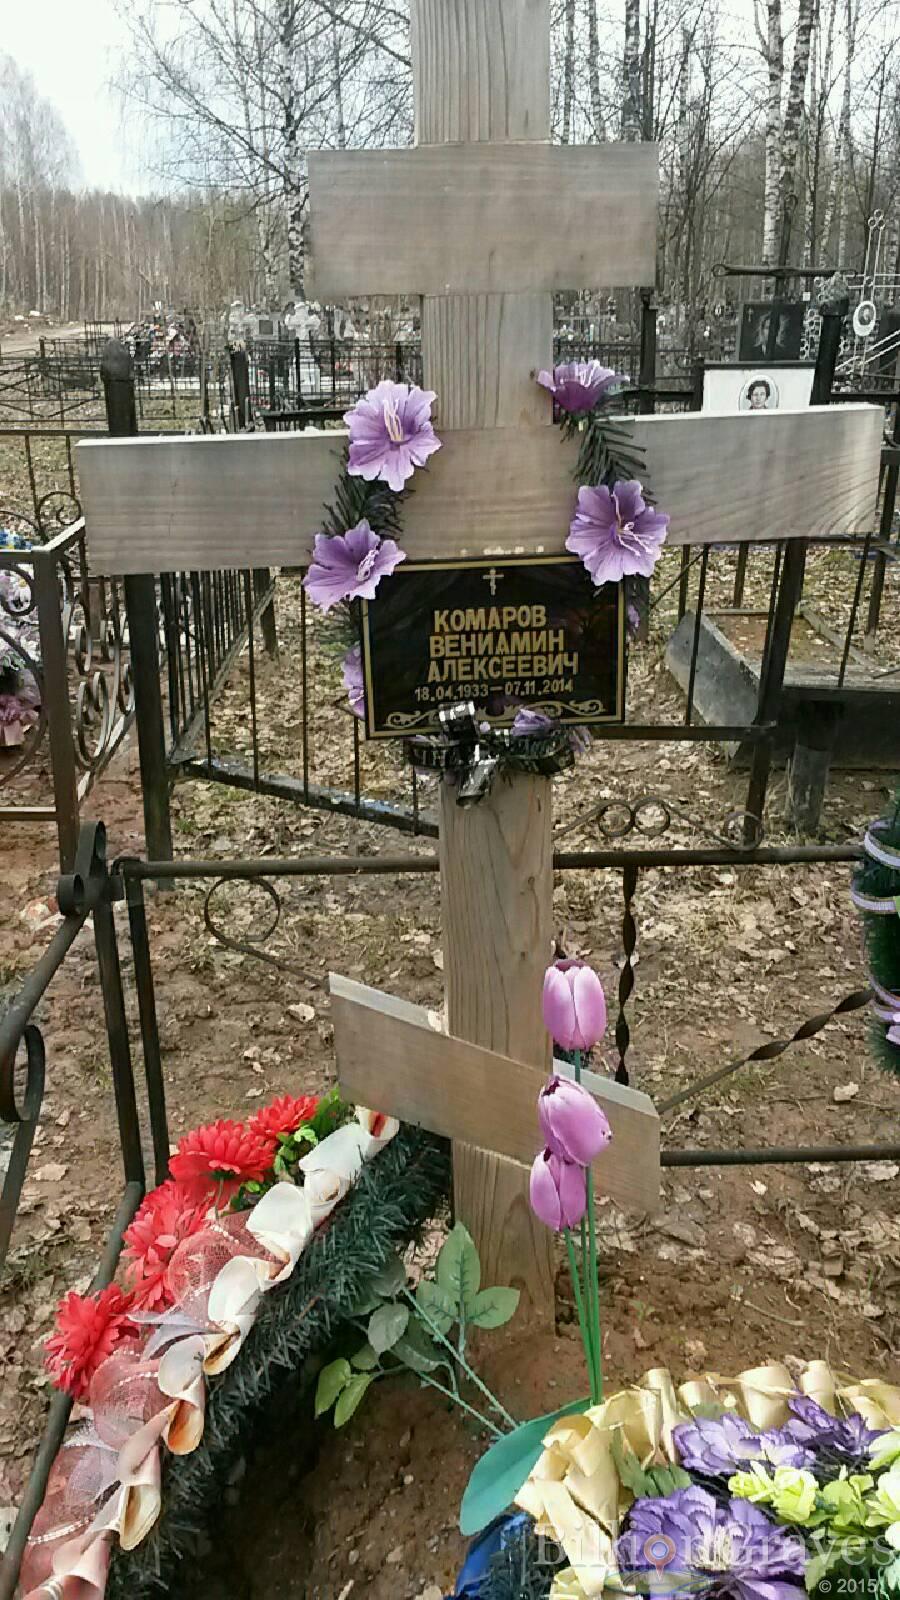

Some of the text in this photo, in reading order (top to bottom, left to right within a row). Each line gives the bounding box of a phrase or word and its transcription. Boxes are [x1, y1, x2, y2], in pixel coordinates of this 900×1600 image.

[433, 604, 547, 633] КОМАРОВ
[429, 629, 565, 658] ВЕНИАМИН
[427, 651, 579, 683] АЛЕКСЕЕВИЧ
